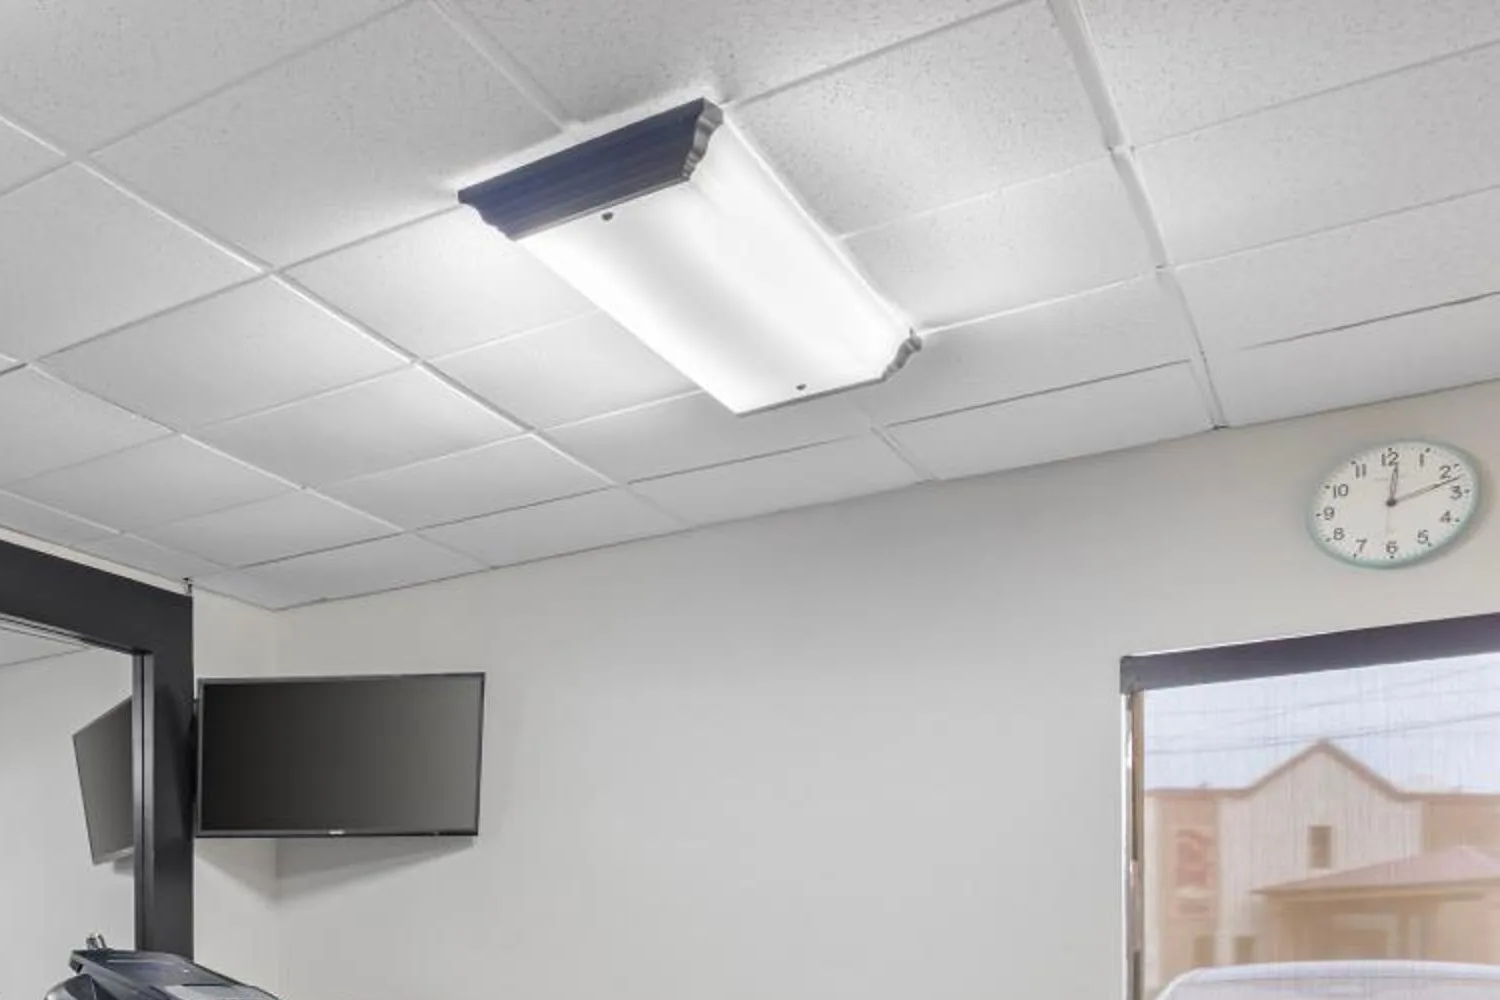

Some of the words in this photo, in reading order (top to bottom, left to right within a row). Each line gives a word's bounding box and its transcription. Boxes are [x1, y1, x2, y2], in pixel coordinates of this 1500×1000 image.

[1381, 452, 1398, 466] 12
[1419, 453, 1424, 467] 1
[1356, 463, 1367, 479] 11
[1440, 465, 1451, 479] 2
[1333, 483, 1349, 500] 10
[1450, 485, 1463, 500] 3
[1323, 506, 1335, 521] 9
[1440, 510, 1451, 523] 4
[1333, 527, 1345, 541] 8
[1417, 529, 1429, 544] 5
[1355, 538, 1368, 552] 7
[1385, 541, 1399, 555] 6
